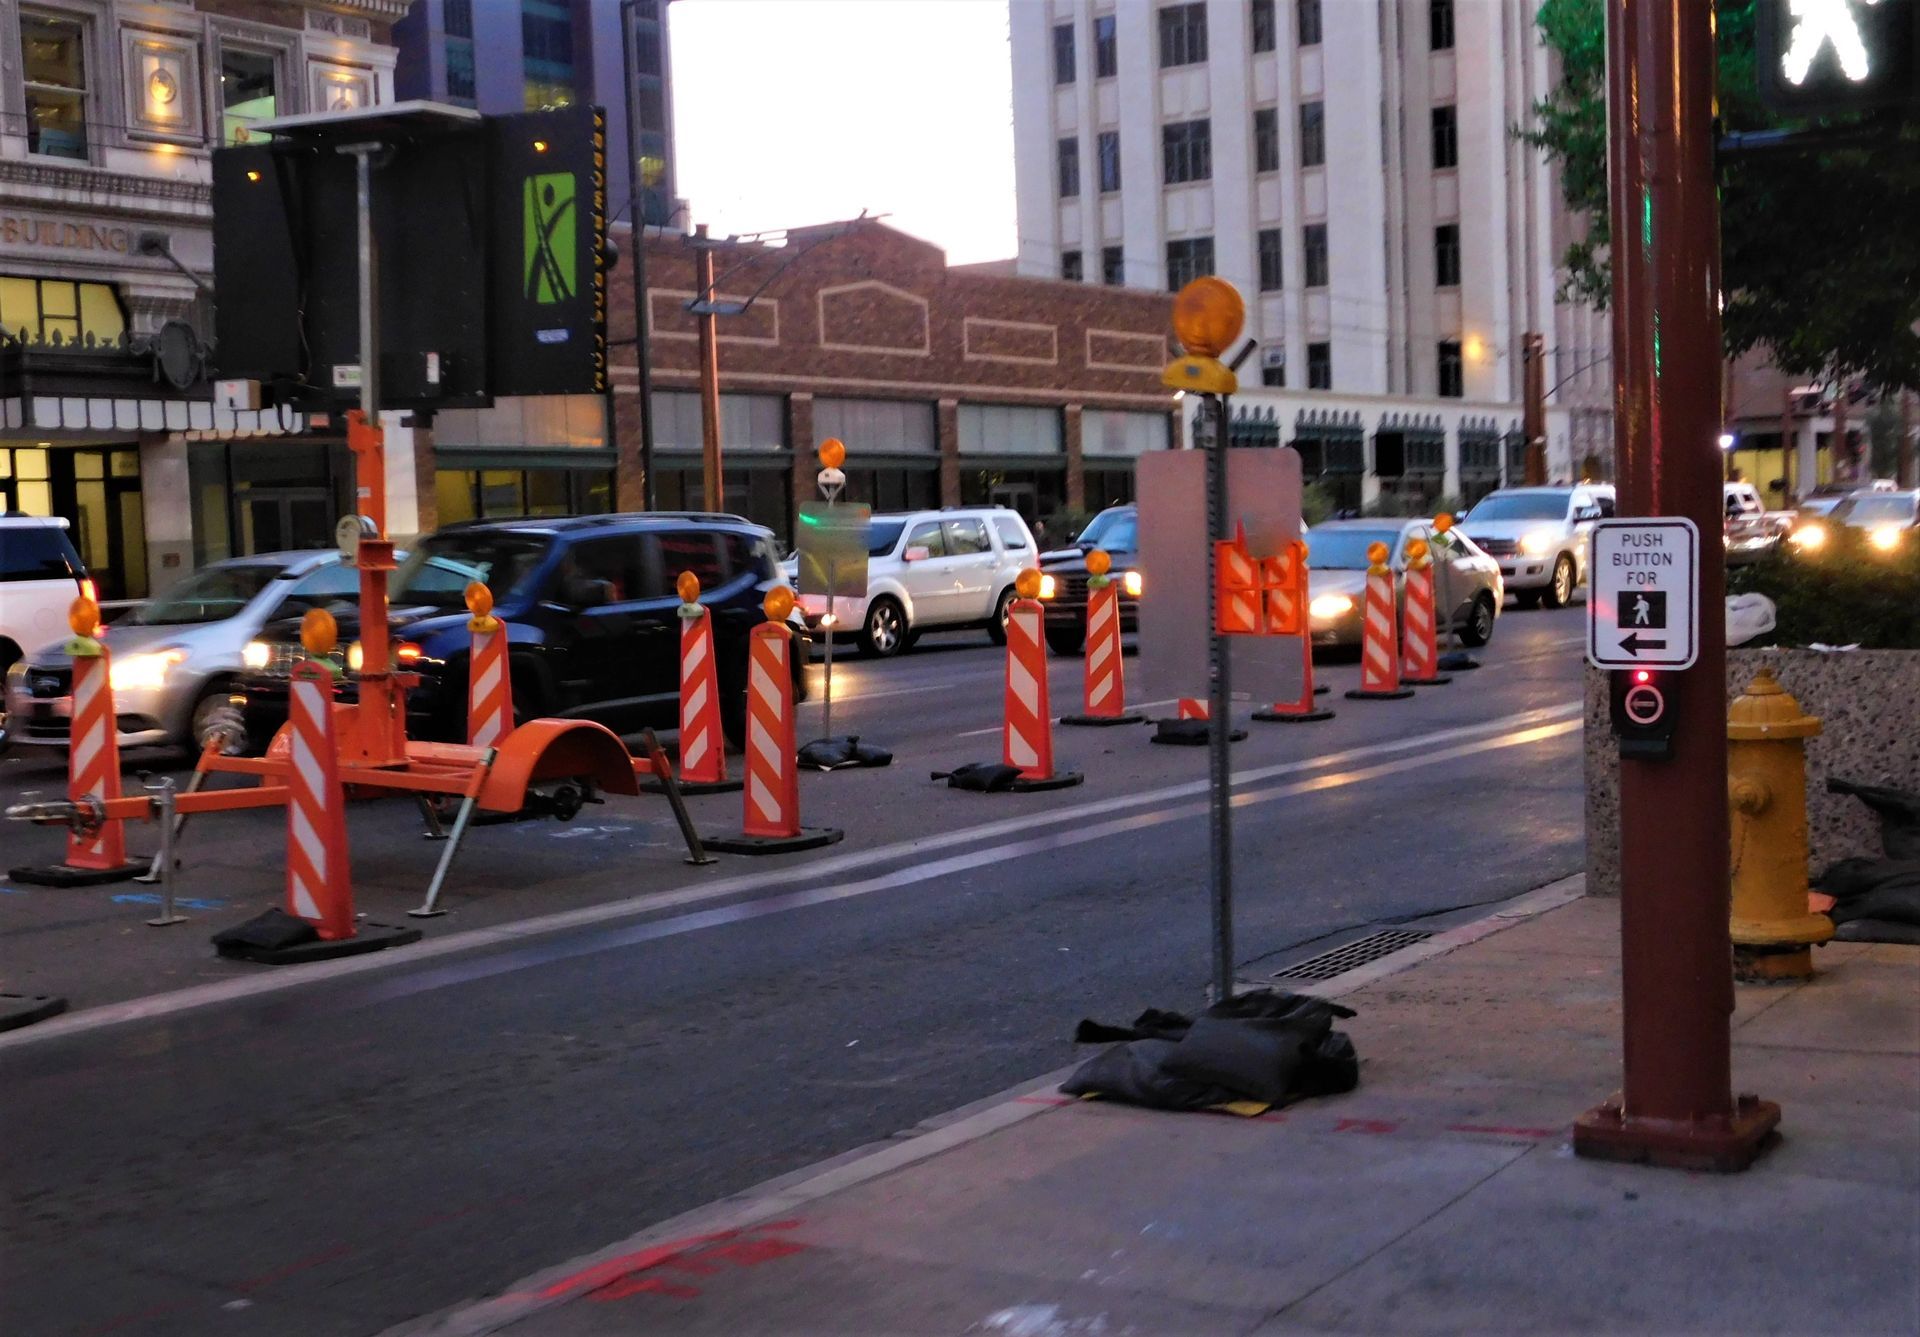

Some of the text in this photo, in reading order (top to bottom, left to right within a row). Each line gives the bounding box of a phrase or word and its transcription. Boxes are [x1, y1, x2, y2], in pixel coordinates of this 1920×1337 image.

[2, 216, 129, 254] BUILDING
[593, 113, 604, 389] ARROWBOARDSCOM
[1622, 533, 1663, 547] PUSH
[1612, 552, 1672, 566] BUTTON
[1627, 571, 1657, 585] FOR
